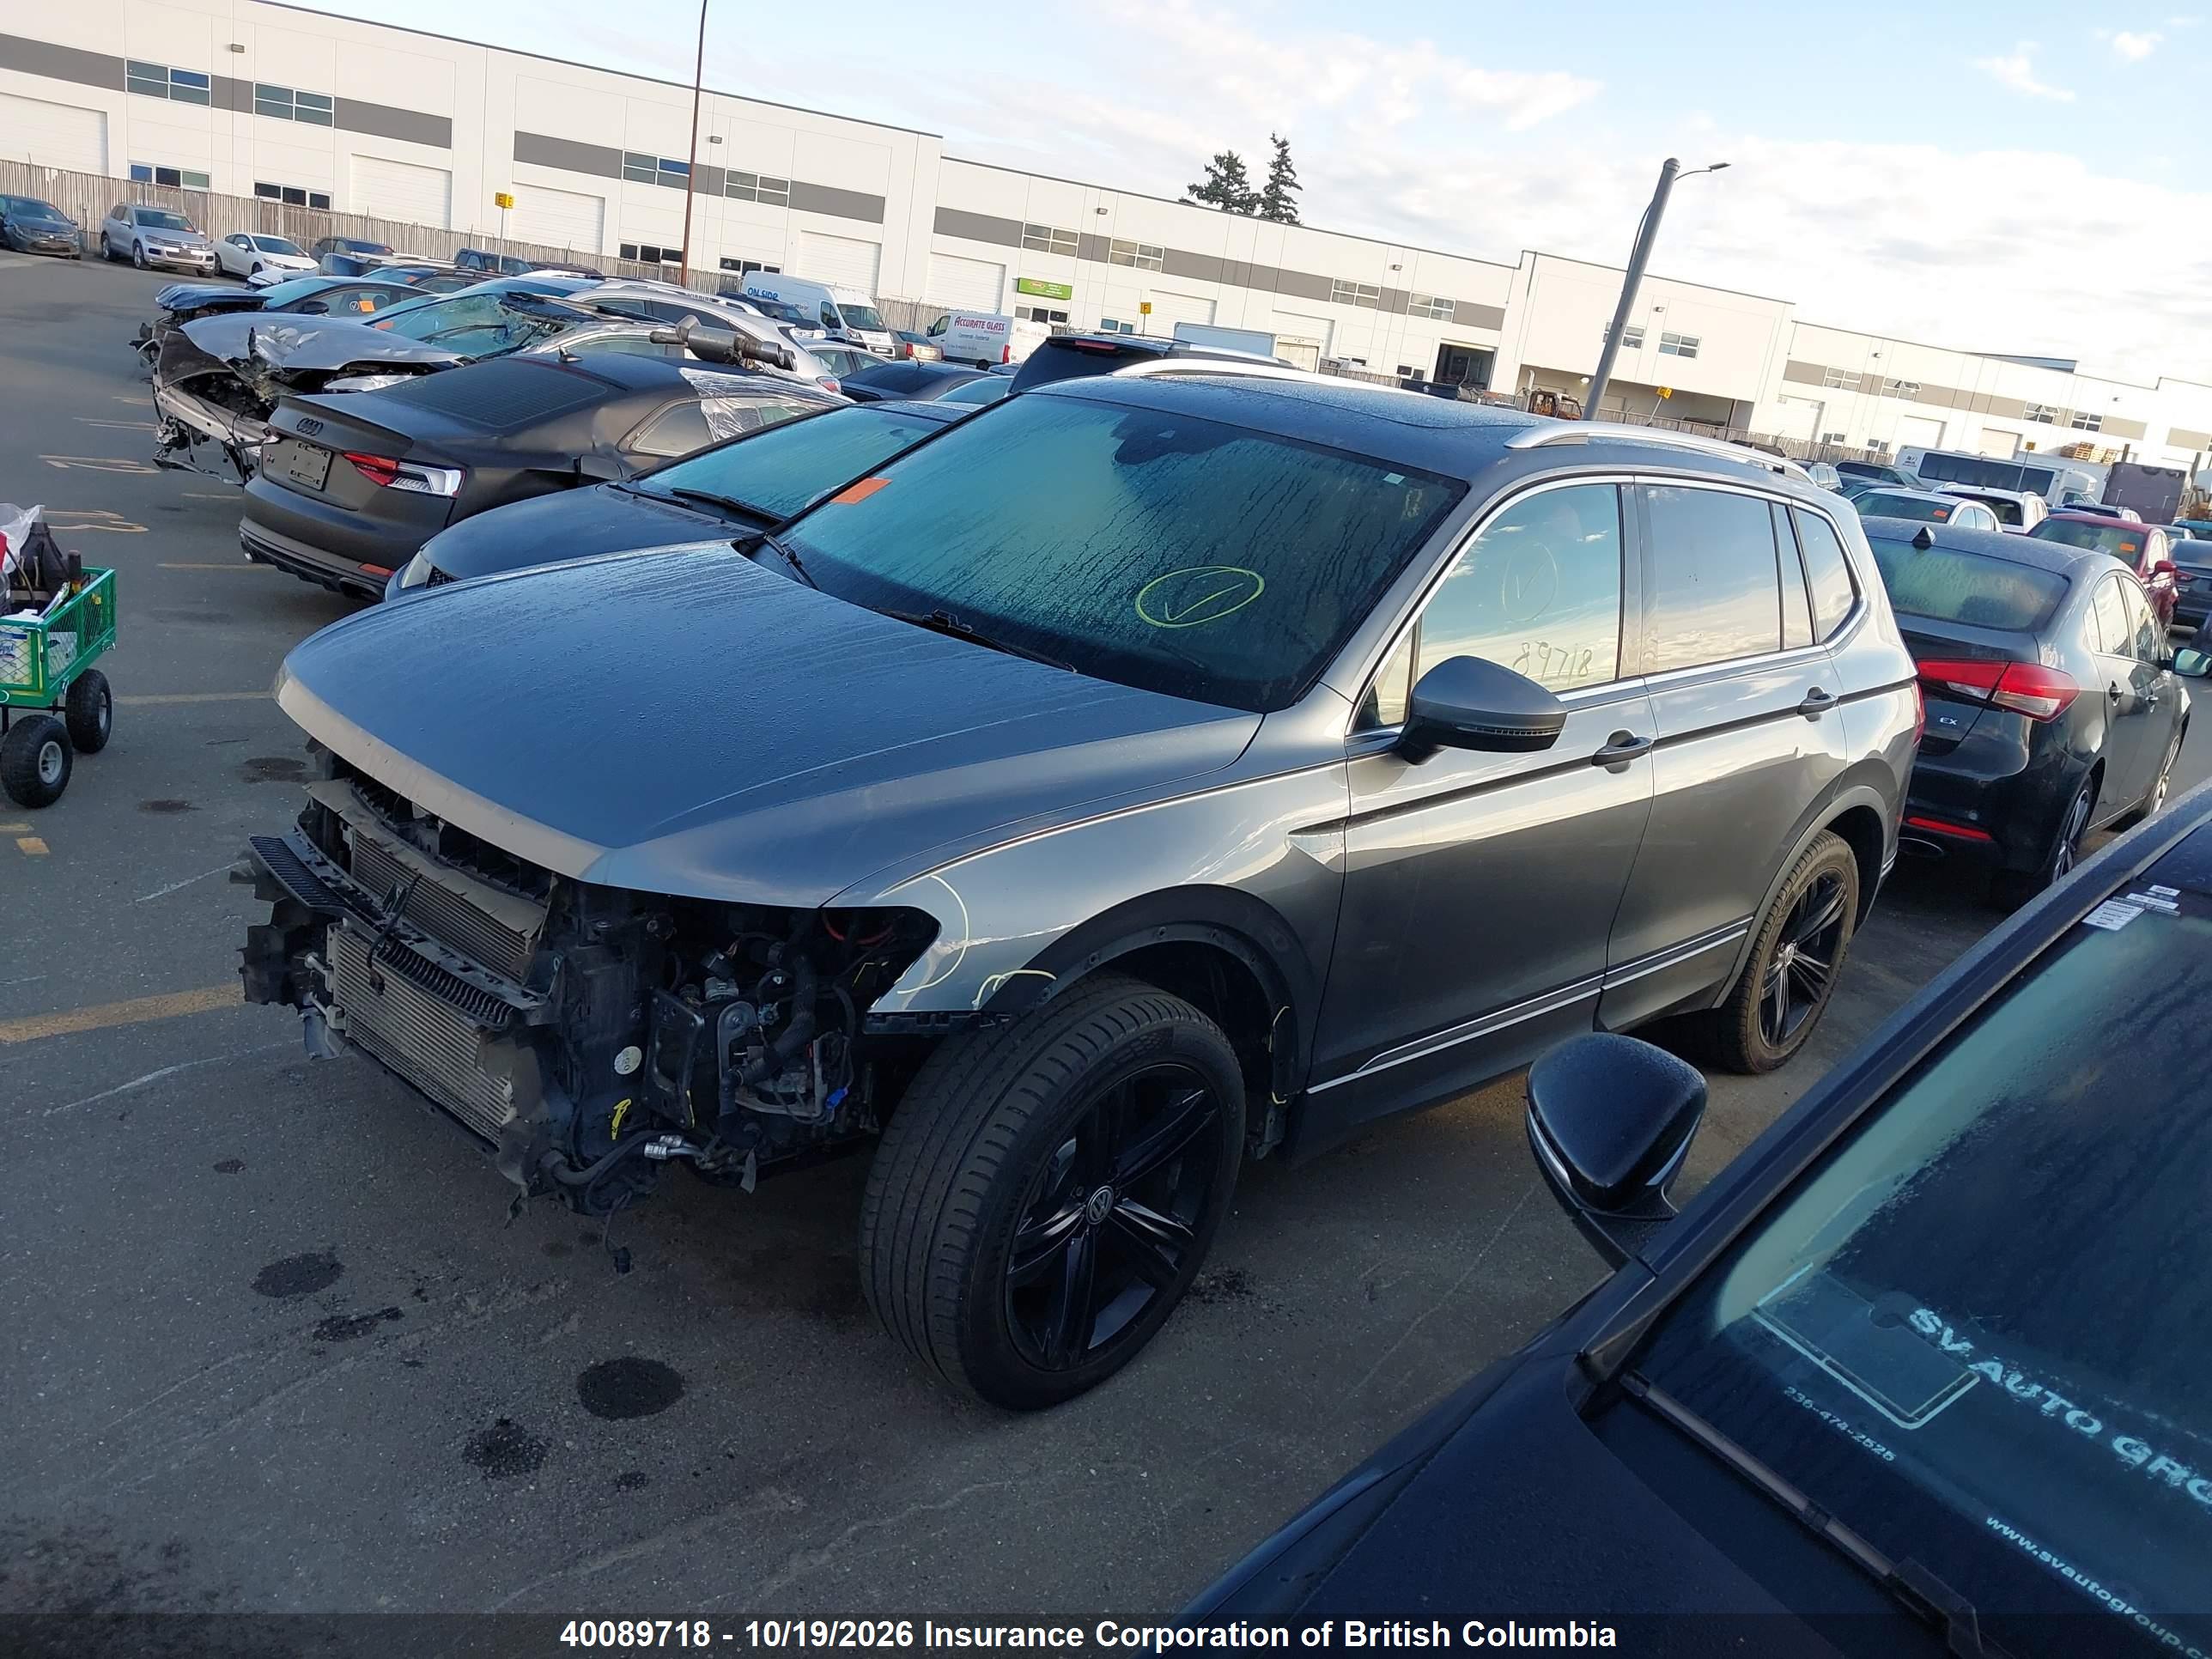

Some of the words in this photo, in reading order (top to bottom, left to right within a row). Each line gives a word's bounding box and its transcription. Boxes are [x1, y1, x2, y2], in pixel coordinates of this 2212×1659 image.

[987, 321, 1006, 331] GLASS
[1512, 641, 1593, 686] 89718
[1940, 717, 1958, 726] EX
[1910, 1308, 1974, 1353] SV
[1968, 1359, 2103, 1435] AUTO
[1985, 1516, 2212, 1659] www.svautogroup.c
